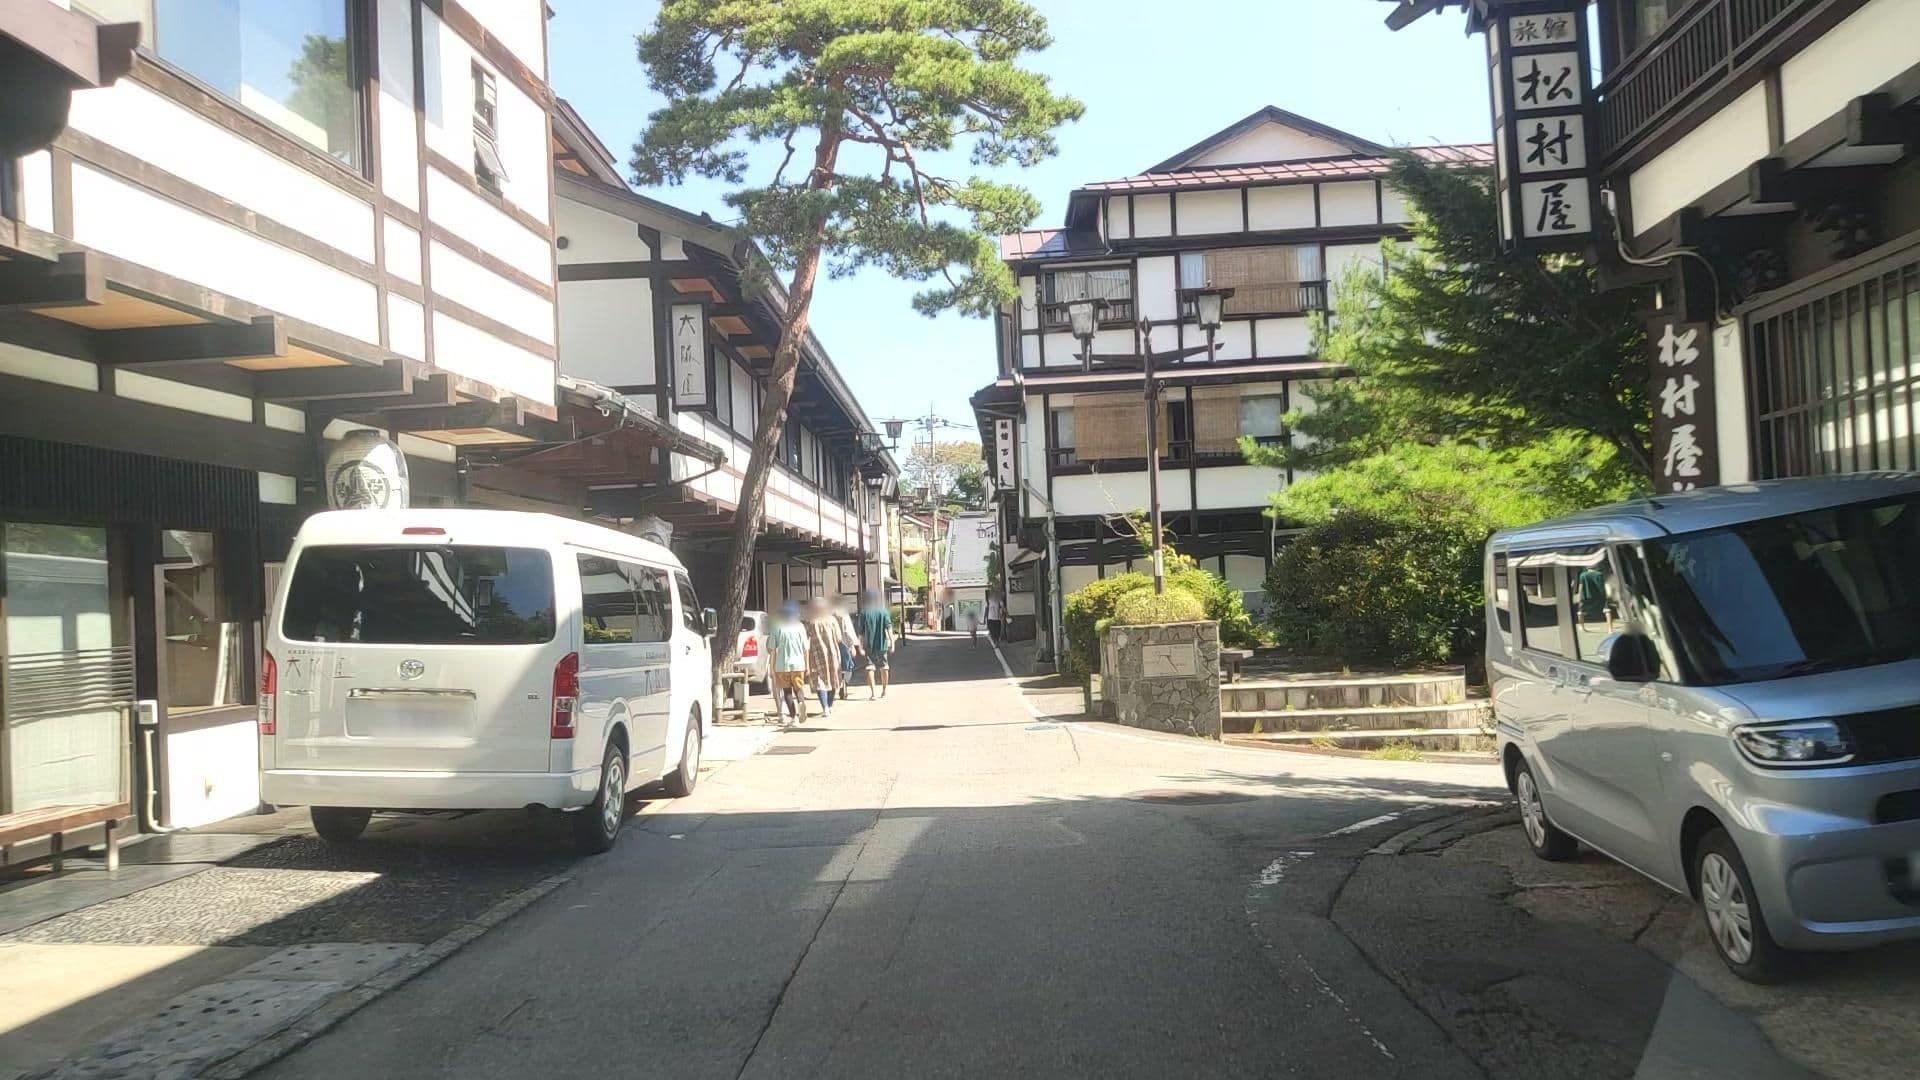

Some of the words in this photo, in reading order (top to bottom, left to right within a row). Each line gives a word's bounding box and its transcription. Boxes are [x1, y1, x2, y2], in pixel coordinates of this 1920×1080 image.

[1513, 17, 1569, 42] 旅館
[1516, 58, 1576, 232] 松村屋
[1656, 323, 1704, 492] 松村屋
